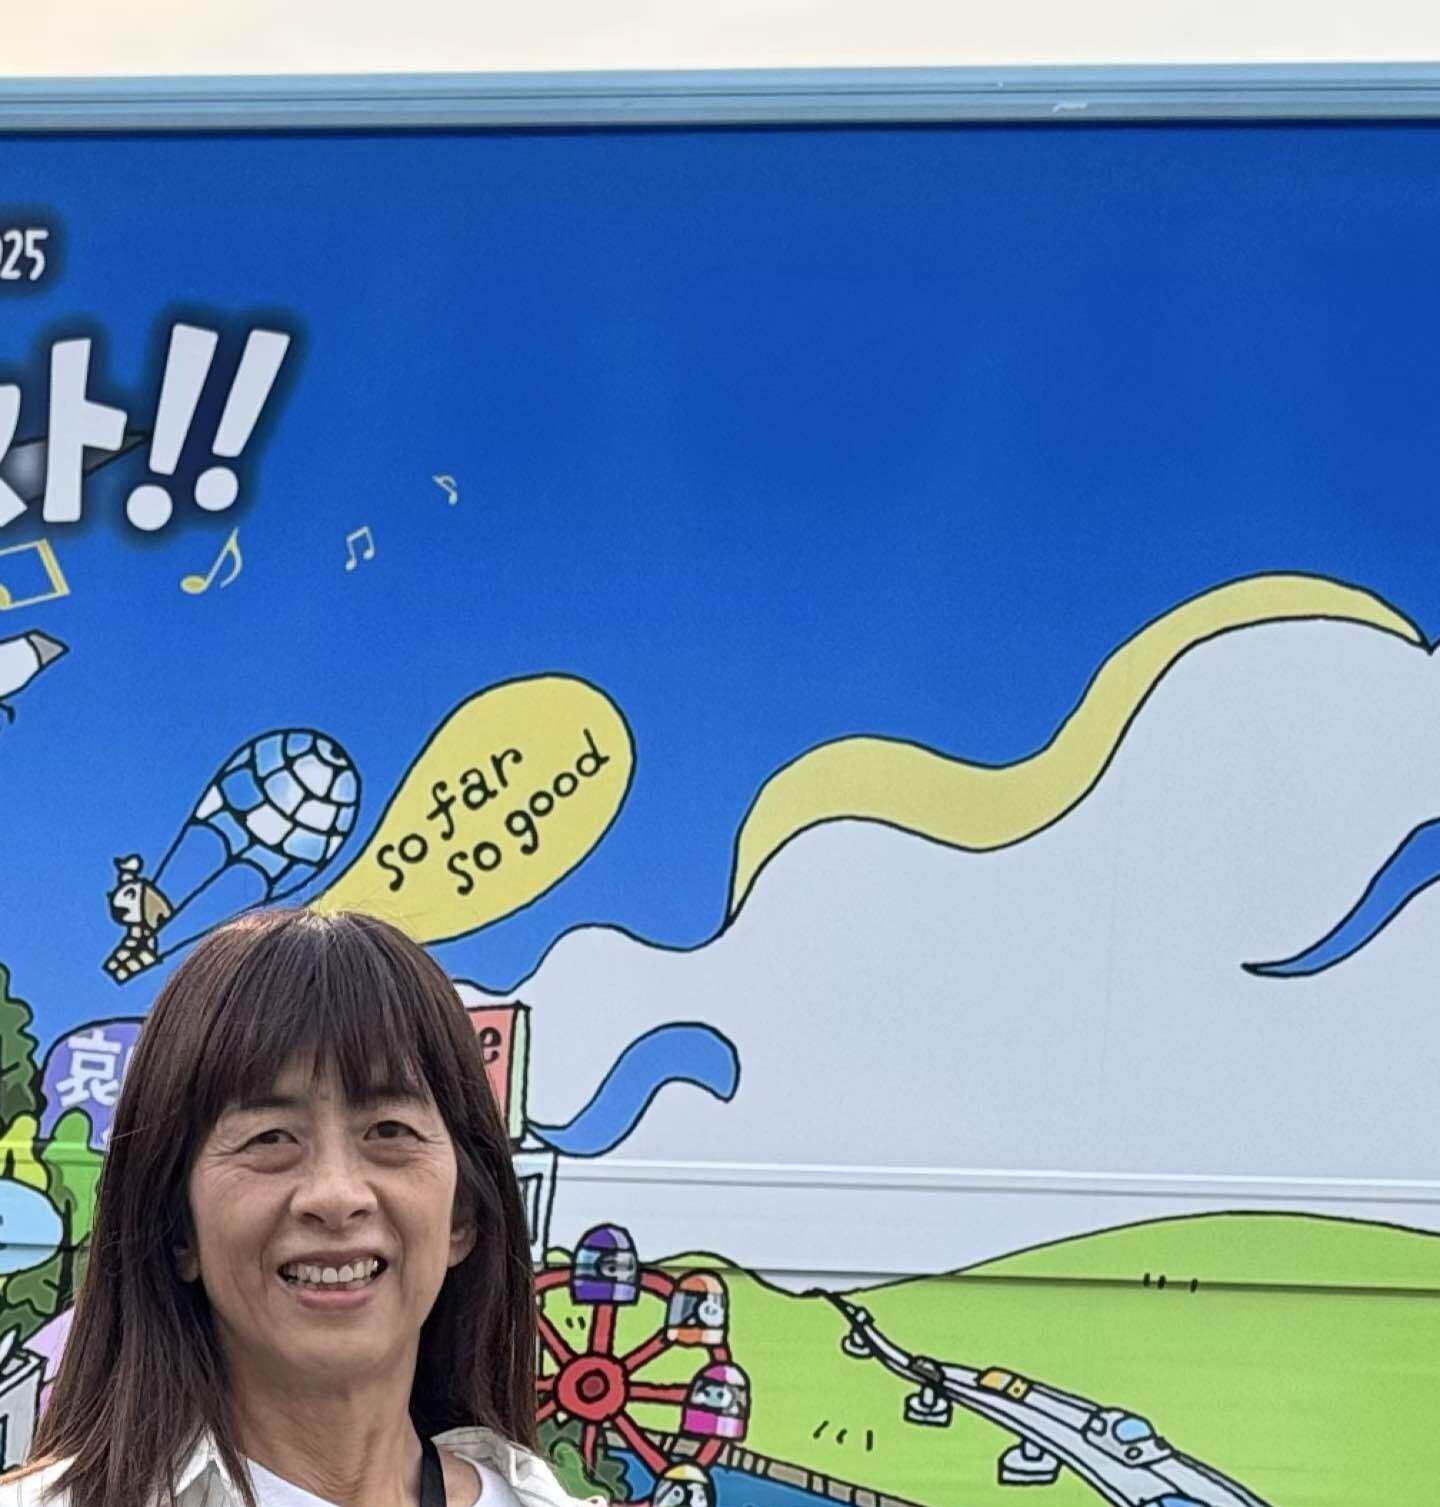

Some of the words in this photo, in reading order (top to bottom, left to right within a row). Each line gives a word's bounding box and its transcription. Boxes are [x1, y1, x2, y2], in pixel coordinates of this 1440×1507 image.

[376, 833, 428, 892] so
[426, 748, 523, 841] far
[447, 841, 502, 896] so
[504, 728, 611, 856] good
